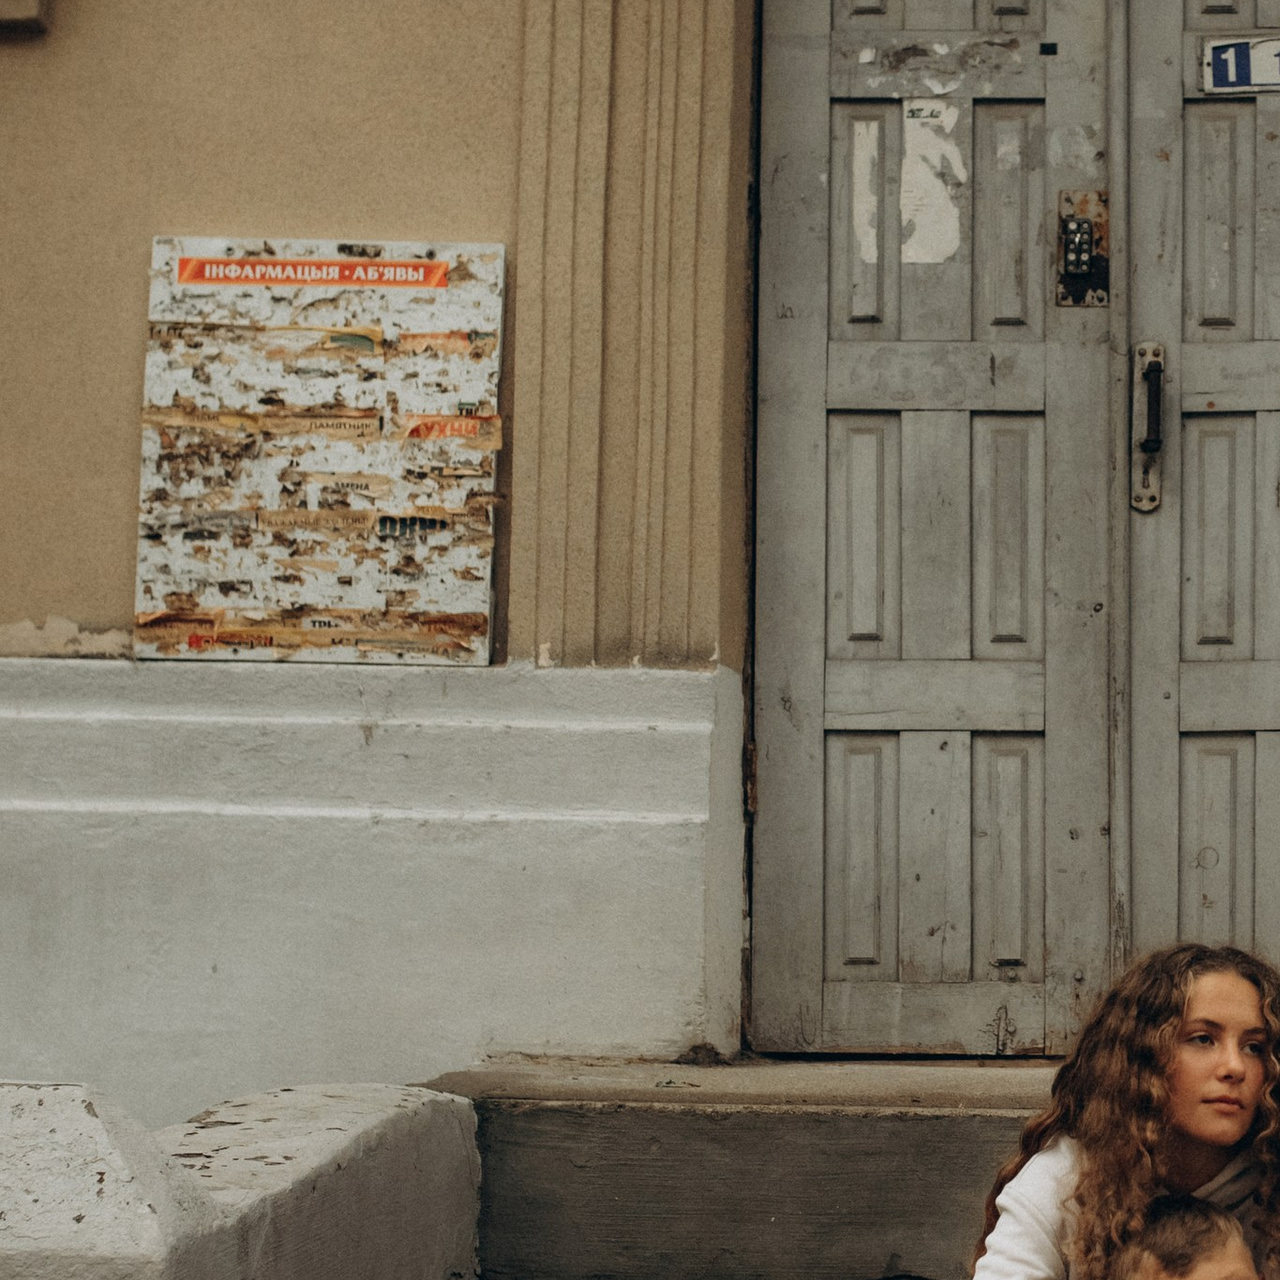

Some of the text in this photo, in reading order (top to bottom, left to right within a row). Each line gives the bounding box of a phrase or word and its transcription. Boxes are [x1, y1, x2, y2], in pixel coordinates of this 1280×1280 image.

[1220, 47, 1237, 82] 1
[204, 263, 425, 282] ІНФАРМАЦЫЯ АБ'ЯВЫ
